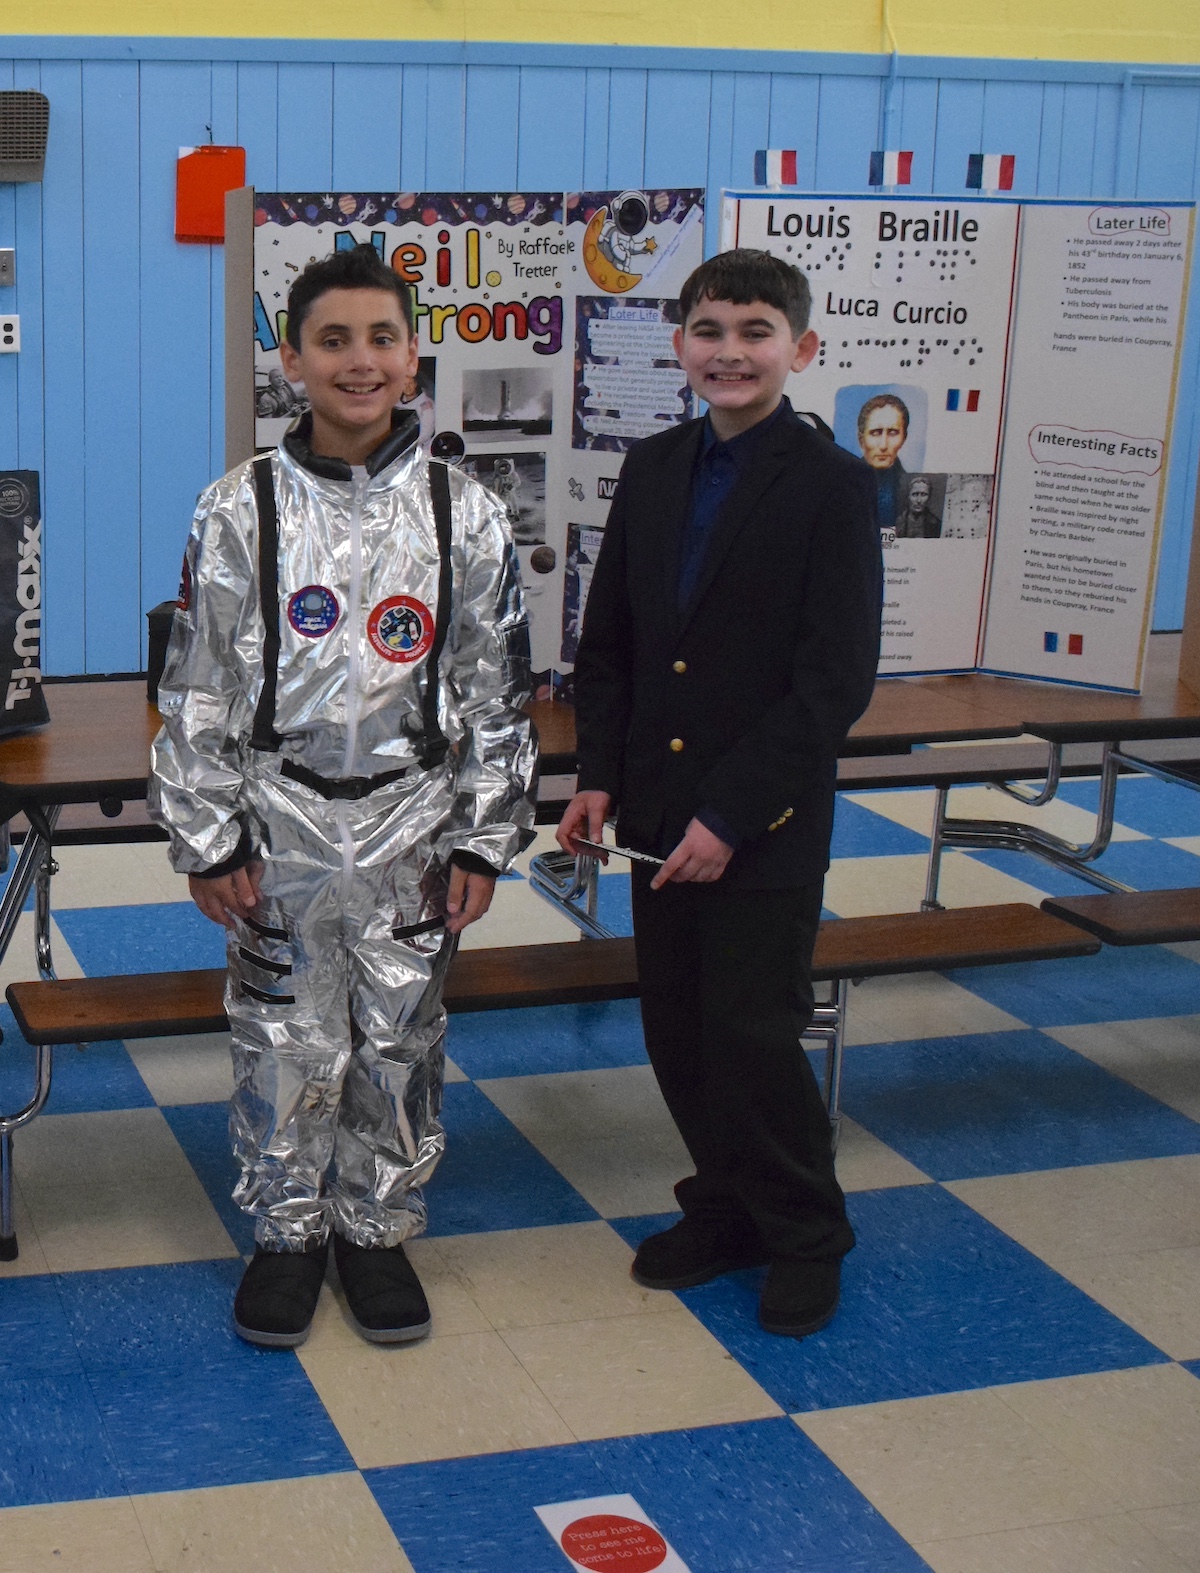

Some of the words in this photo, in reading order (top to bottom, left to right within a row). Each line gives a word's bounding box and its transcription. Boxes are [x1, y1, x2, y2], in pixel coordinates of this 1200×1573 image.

[767, 206, 850, 238] Louis
[878, 210, 979, 242] Braille
[1096, 217, 1134, 229] Later
[1140, 216, 1166, 229] Life
[498, 238, 514, 258] By
[519, 238, 575, 256] Raffaele
[1085, 239, 1112, 247] passed
[1114, 240, 1133, 248] away
[1143, 240, 1160, 248] days
[1098, 251, 1130, 260] birthday
[1144, 252, 1174, 260] January
[513, 262, 558, 279] Tretter
[1082, 276, 1108, 284] passed
[1066, 288, 1112, 296] Tuberculosis
[826, 292, 879, 317] Luca
[893, 300, 967, 324] Curcio
[1081, 301, 1100, 309] body
[640, 309, 658, 319] Life
[1063, 312, 1098, 320] Pantheon
[1110, 314, 1130, 322] Paris,
[1133, 316, 1154, 324] while
[1156, 316, 1167, 324] his
[1054, 332, 1076, 340] hands
[1098, 335, 1123, 343] buried
[1134, 337, 1172, 347] Coupvray,
[1052, 344, 1076, 352] France
[1038, 431, 1116, 456] Interesting
[1120, 442, 1158, 459] Facts
[1053, 471, 1086, 481] attended
[1094, 476, 1118, 485] school
[1120, 478, 1130, 487] for
[1036, 481, 1054, 489] blind
[1056, 483, 1070, 491] and
[1072, 486, 1089, 494] then
[1091, 488, 1115, 498] taught
[1126, 492, 1139, 500] the
[1055, 495, 1079, 505] school
[1080, 498, 1101, 507] when
[1131, 506, 1151, 514] older
[1036, 505, 1059, 514] Braille
[1077, 510, 1106, 521] inspired
[1108, 514, 1118, 522] by
[1120, 516, 1139, 525] night
[1030, 528, 1038, 536] by
[1040, 530, 1066, 539] Charles
[1068, 534, 1096, 543] Barbier
[1067, 522, 1095, 532] military
[1097, 526, 1115, 534] code
[1117, 528, 1145, 538] created
[1058, 553, 1092, 564] originally
[1093, 557, 1118, 567] buried
[1025, 560, 1045, 569] Paris,
[1073, 566, 1113, 578] hometown
[1024, 572, 1051, 582] wanted
[1053, 575, 1066, 583] him
[1089, 581, 1113, 590] buried
[1115, 584, 1137, 593] closer
[1032, 584, 1053, 594] them,
[1065, 590, 1081, 598] they
[1083, 592, 1114, 602] reburied
[1116, 596, 1127, 604] his
[1020, 594, 1042, 604] hands
[1090, 604, 1115, 614] France
[568, 1529, 607, 1542] Press
[610, 1524, 642, 1535] here
[580, 1543, 596, 1552] to
[600, 1540, 622, 1549] see
[624, 1536, 646, 1546] me
[578, 1553, 615, 1565] come
[617, 1550, 633, 1558] to
[636, 1544, 665, 1556] life!
